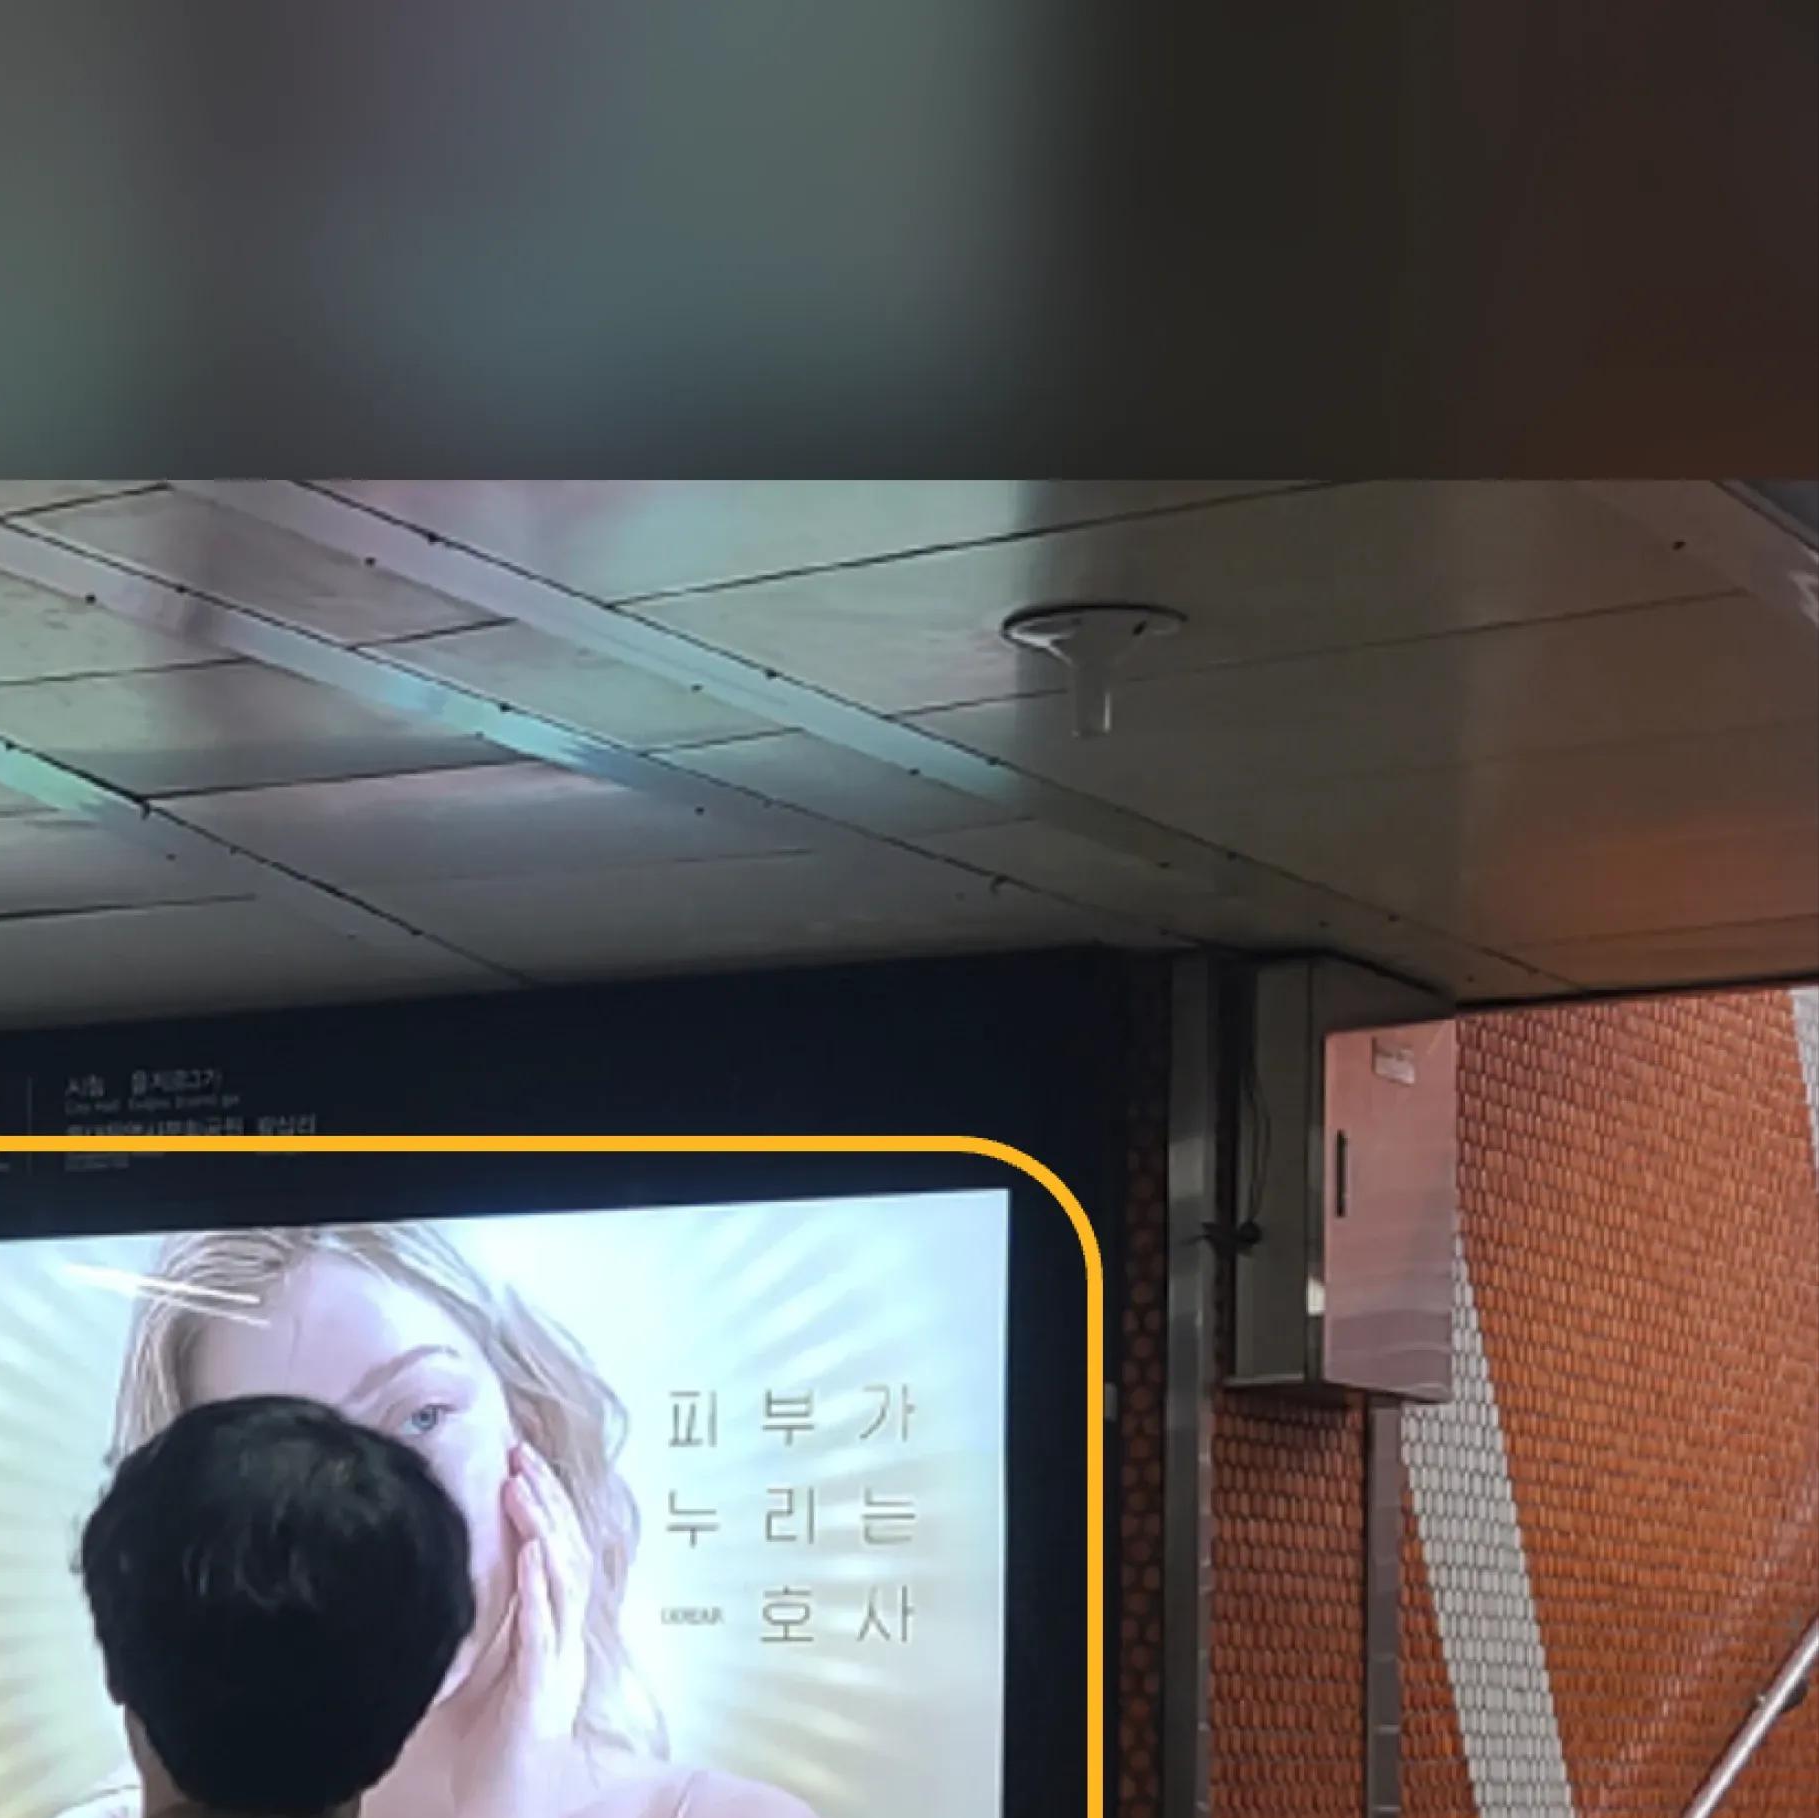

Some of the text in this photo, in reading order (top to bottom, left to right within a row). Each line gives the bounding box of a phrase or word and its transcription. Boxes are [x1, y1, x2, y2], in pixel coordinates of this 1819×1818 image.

[668, 1384, 916, 1448] 피부가
[666, 1486, 917, 1549] 누리는
[759, 1584, 915, 1643] 호사
